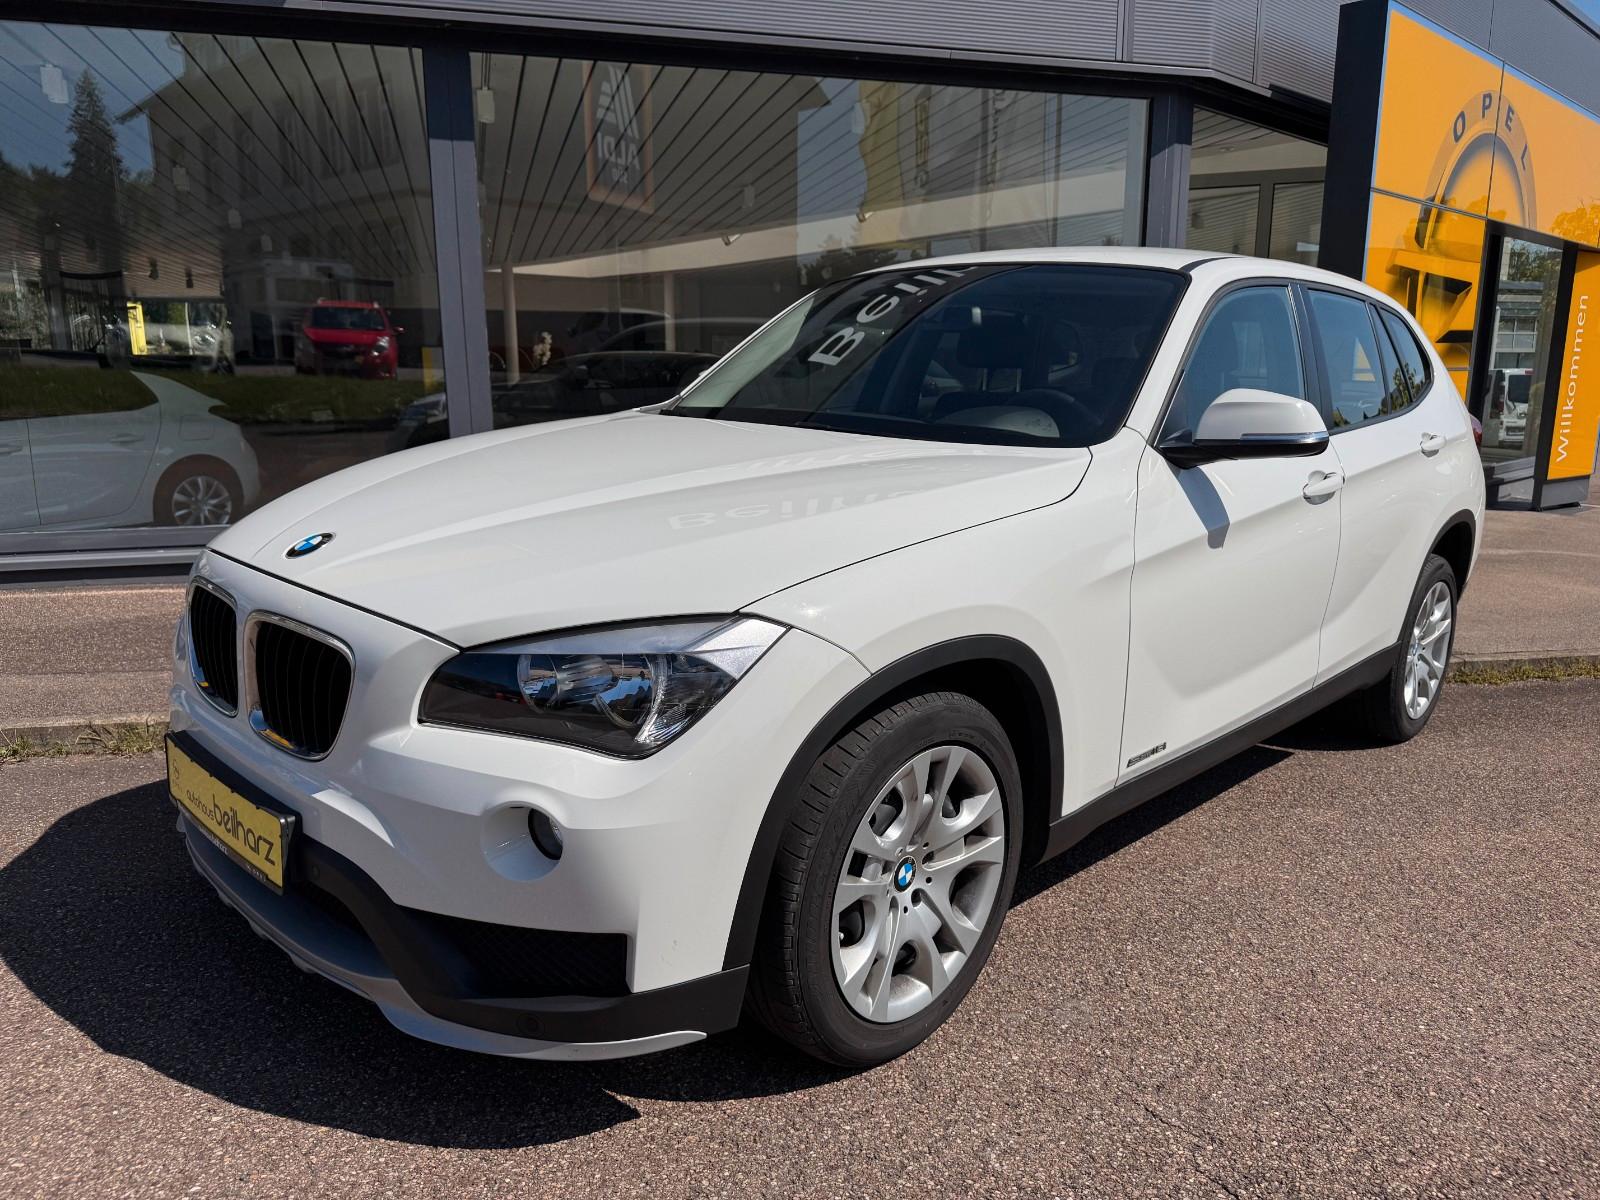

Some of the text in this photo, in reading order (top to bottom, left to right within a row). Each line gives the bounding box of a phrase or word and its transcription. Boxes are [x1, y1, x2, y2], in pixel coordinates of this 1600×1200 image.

[1452, 92, 1528, 171] OPEL
[1556, 294, 1589, 463] Willkommen
[186, 789, 214, 821] autohaus
[212, 793, 276, 866] beilharz
